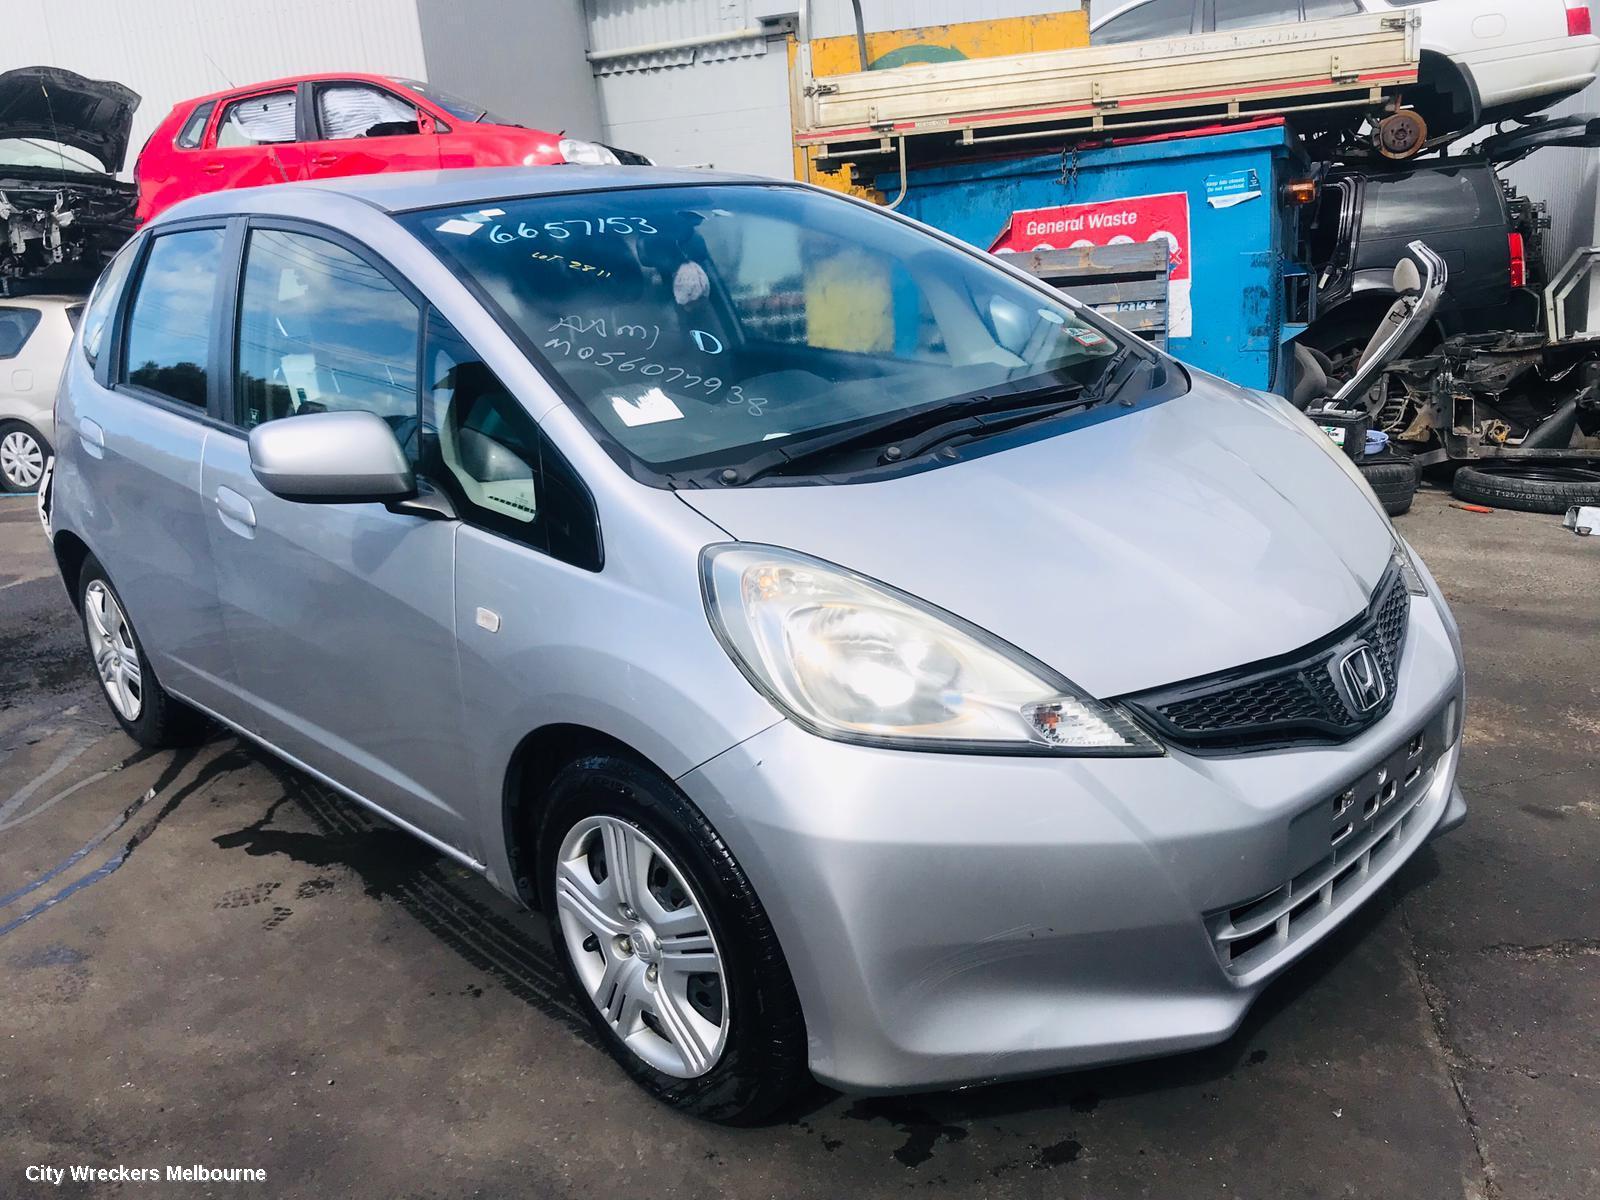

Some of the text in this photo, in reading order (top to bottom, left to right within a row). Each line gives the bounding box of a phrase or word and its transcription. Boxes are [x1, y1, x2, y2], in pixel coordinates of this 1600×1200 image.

[489, 217, 658, 244] 6657153
[1026, 211, 1138, 236] General Waste
[690, 329, 723, 354] D
